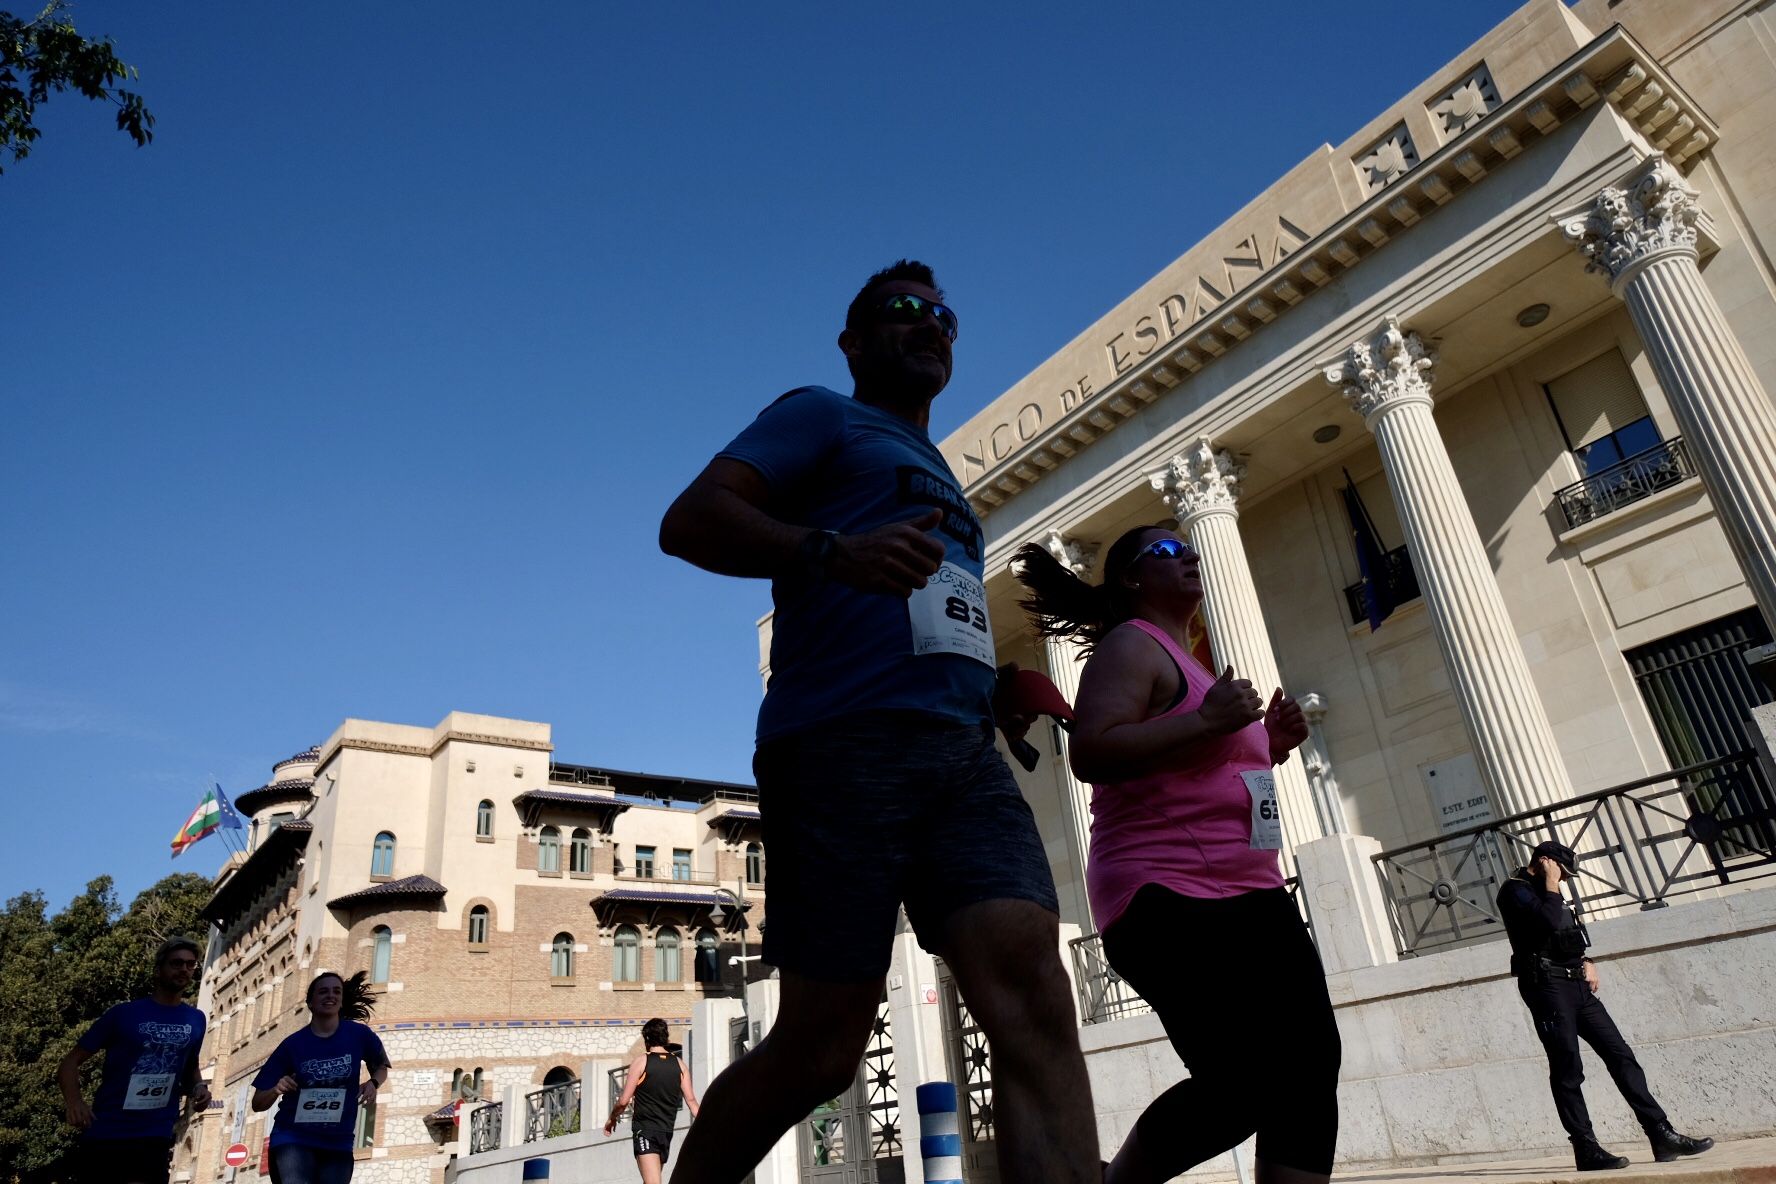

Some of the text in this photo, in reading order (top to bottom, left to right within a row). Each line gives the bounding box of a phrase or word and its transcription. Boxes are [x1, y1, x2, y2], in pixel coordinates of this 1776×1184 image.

[1060, 375, 1094, 415] DE
[1104, 215, 1312, 381] ESPAÑA
[1442, 802, 1465, 815] ESTE
[136, 1086, 169, 1097] 461
[302, 1101, 341, 1111] 648
